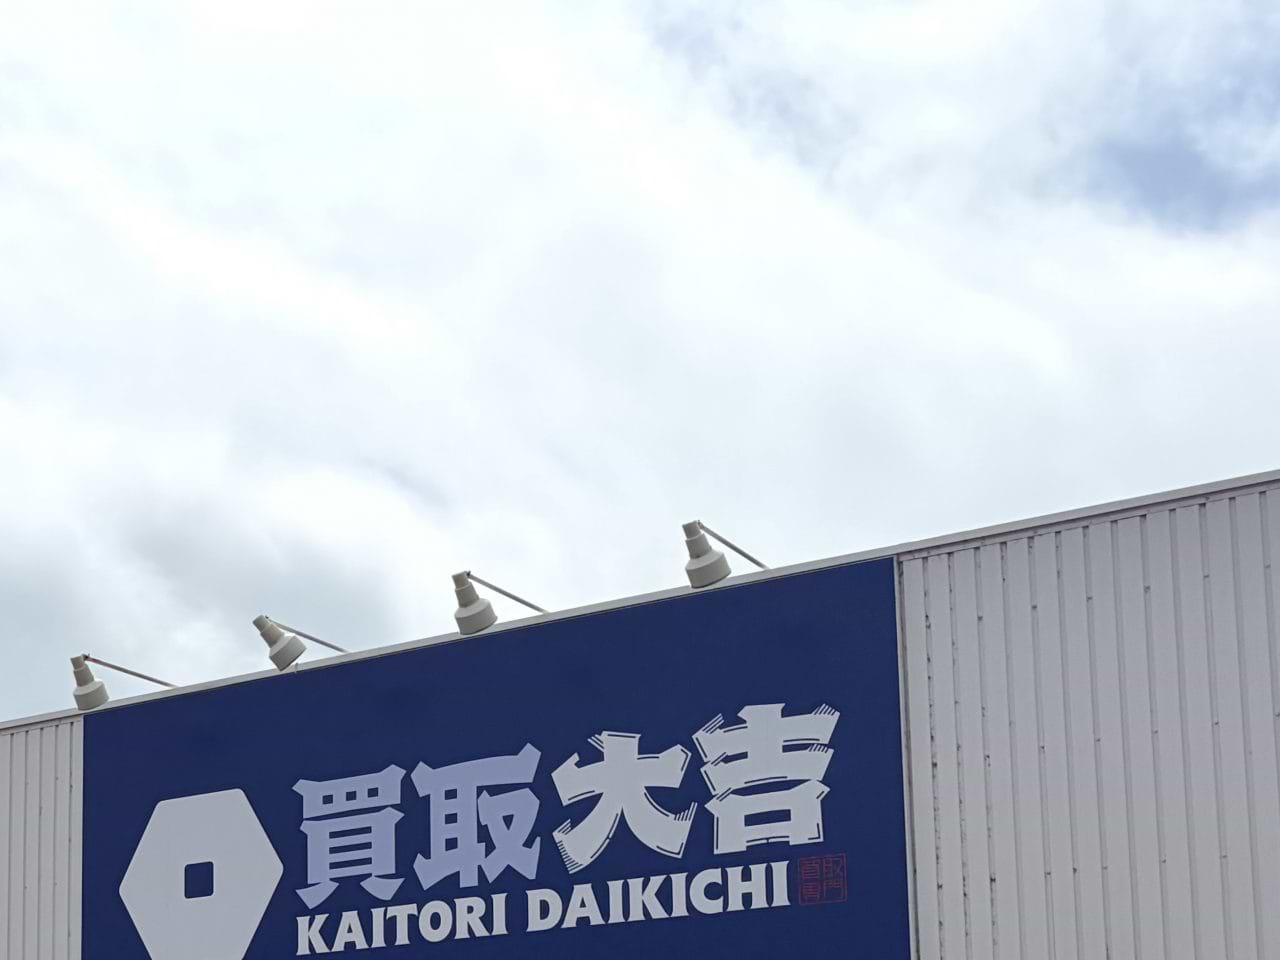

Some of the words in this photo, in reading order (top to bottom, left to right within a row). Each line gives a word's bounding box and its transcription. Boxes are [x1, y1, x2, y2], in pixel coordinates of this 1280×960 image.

[291, 703, 841, 910] 買取大吉
[295, 896, 510, 956] KAITORI
[525, 860, 792, 933] DAIKICHI
